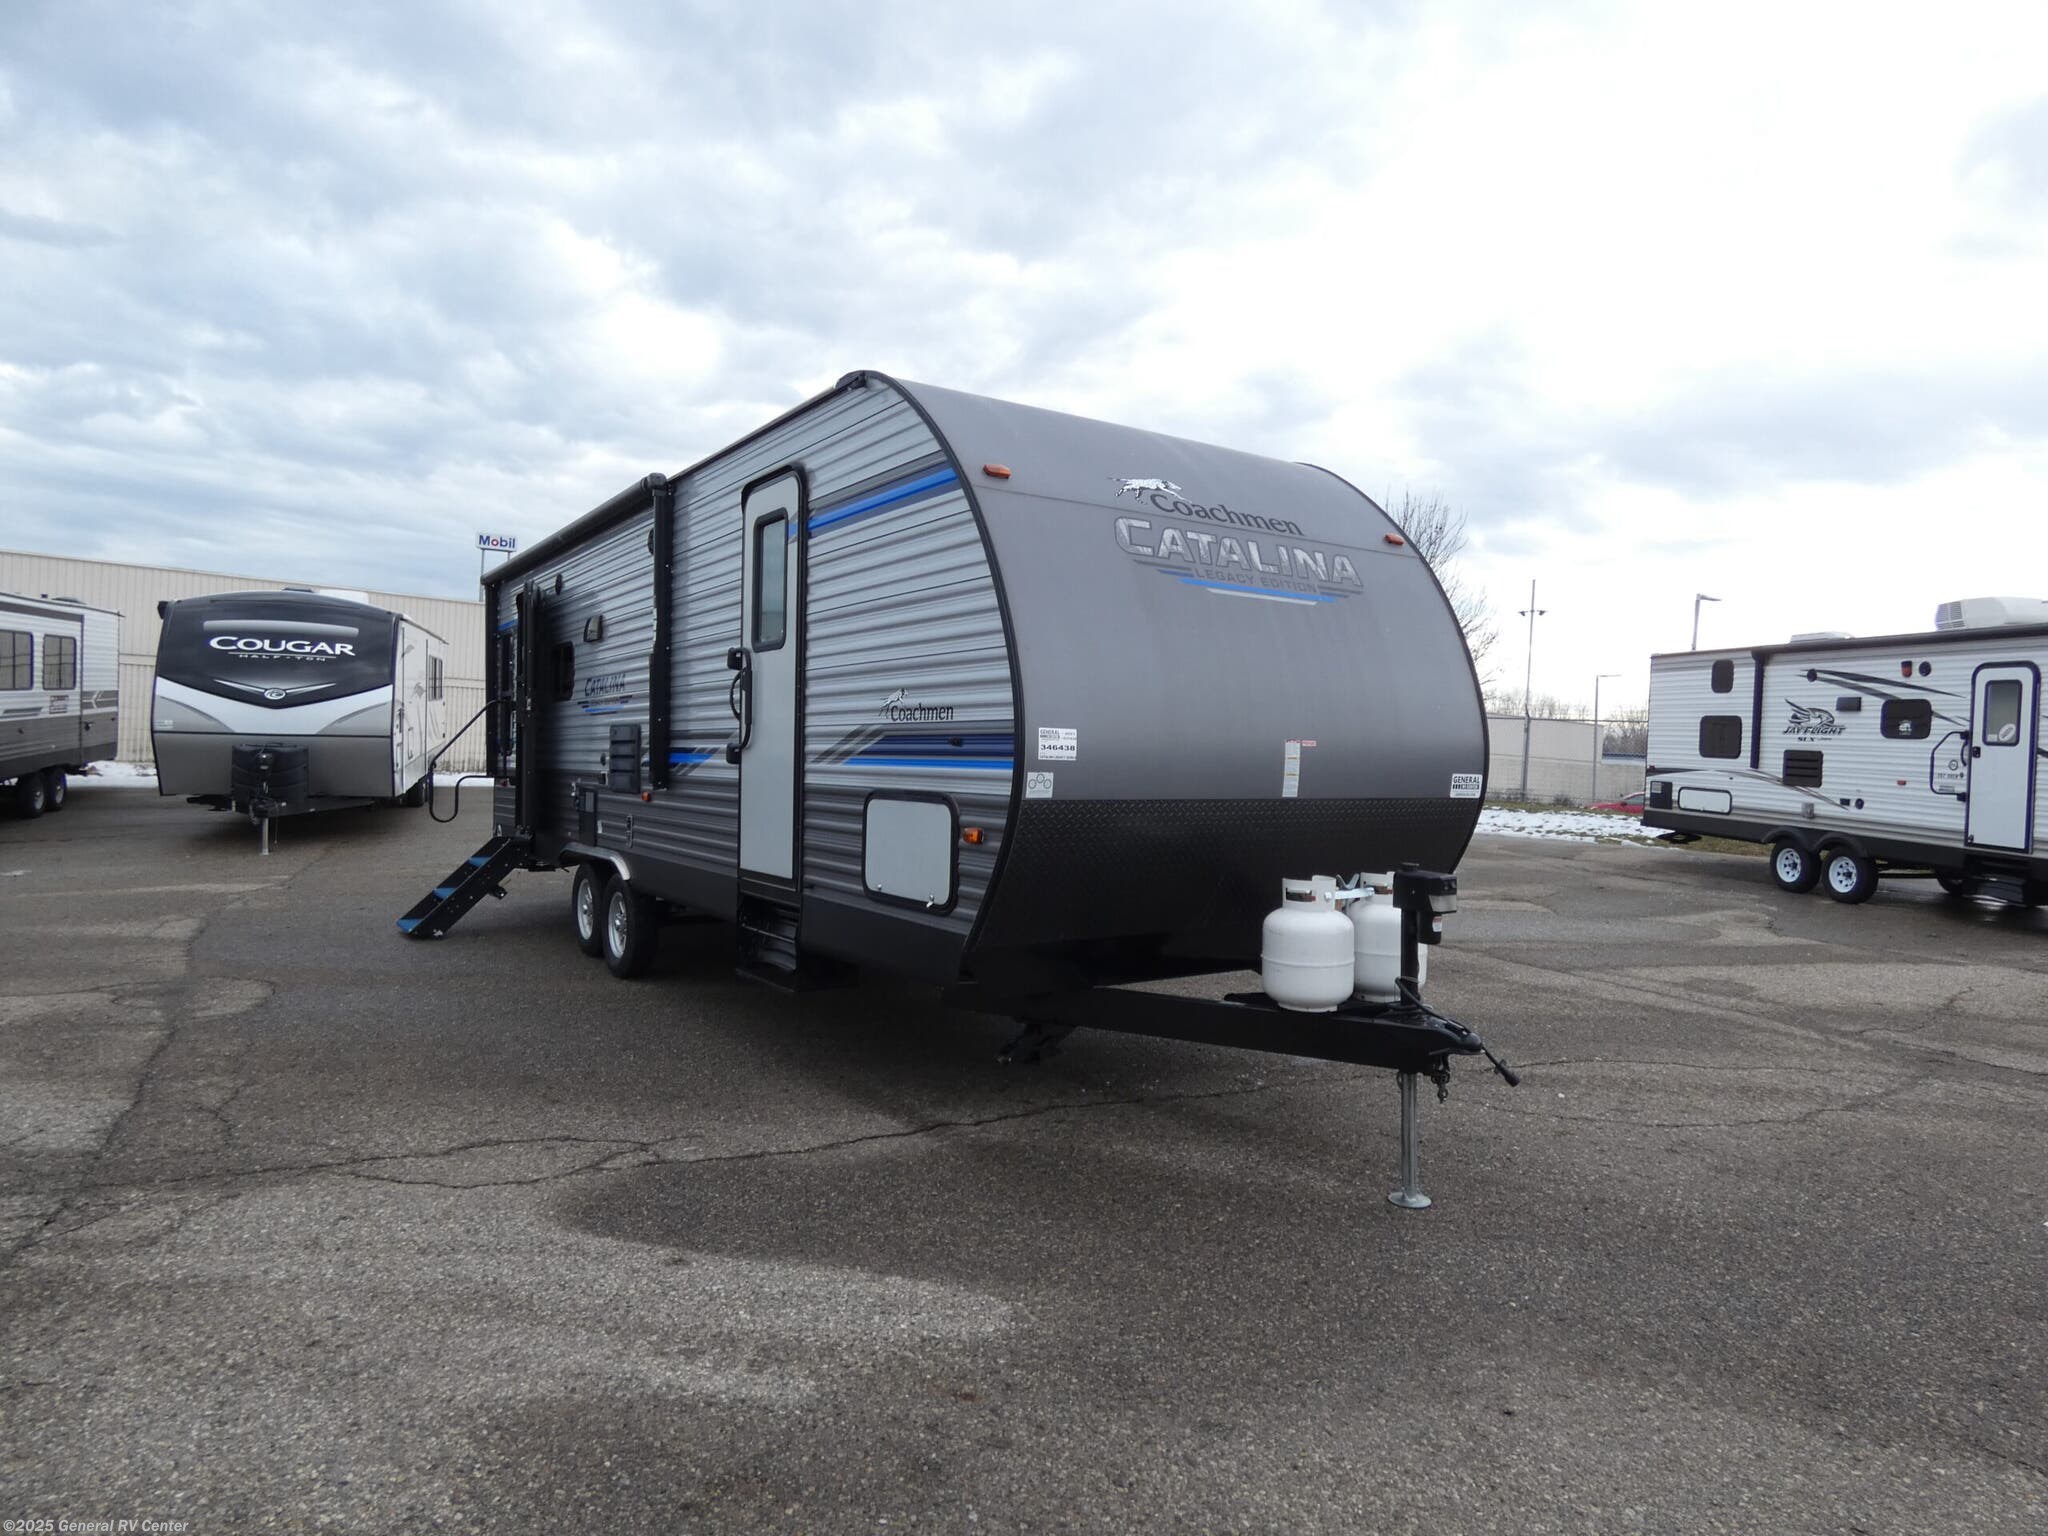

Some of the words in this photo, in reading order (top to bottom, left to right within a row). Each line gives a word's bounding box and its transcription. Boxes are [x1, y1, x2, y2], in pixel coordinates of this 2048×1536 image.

[1150, 493, 1305, 536] Coachmen
[479, 534, 516, 549] Mobil
[1113, 516, 1364, 587] CATALINA
[1194, 568, 1254, 585] LEGACY
[1261, 576, 1319, 593] EDITION
[209, 636, 356, 657] COUGAR
[890, 701, 954, 721] Coachmen
[1782, 726, 1803, 735] JAY
[1804, 726, 1847, 736] FLIGHT
[1040, 744, 1076, 752] 346438
[1453, 775, 1480, 784] GENERAL
